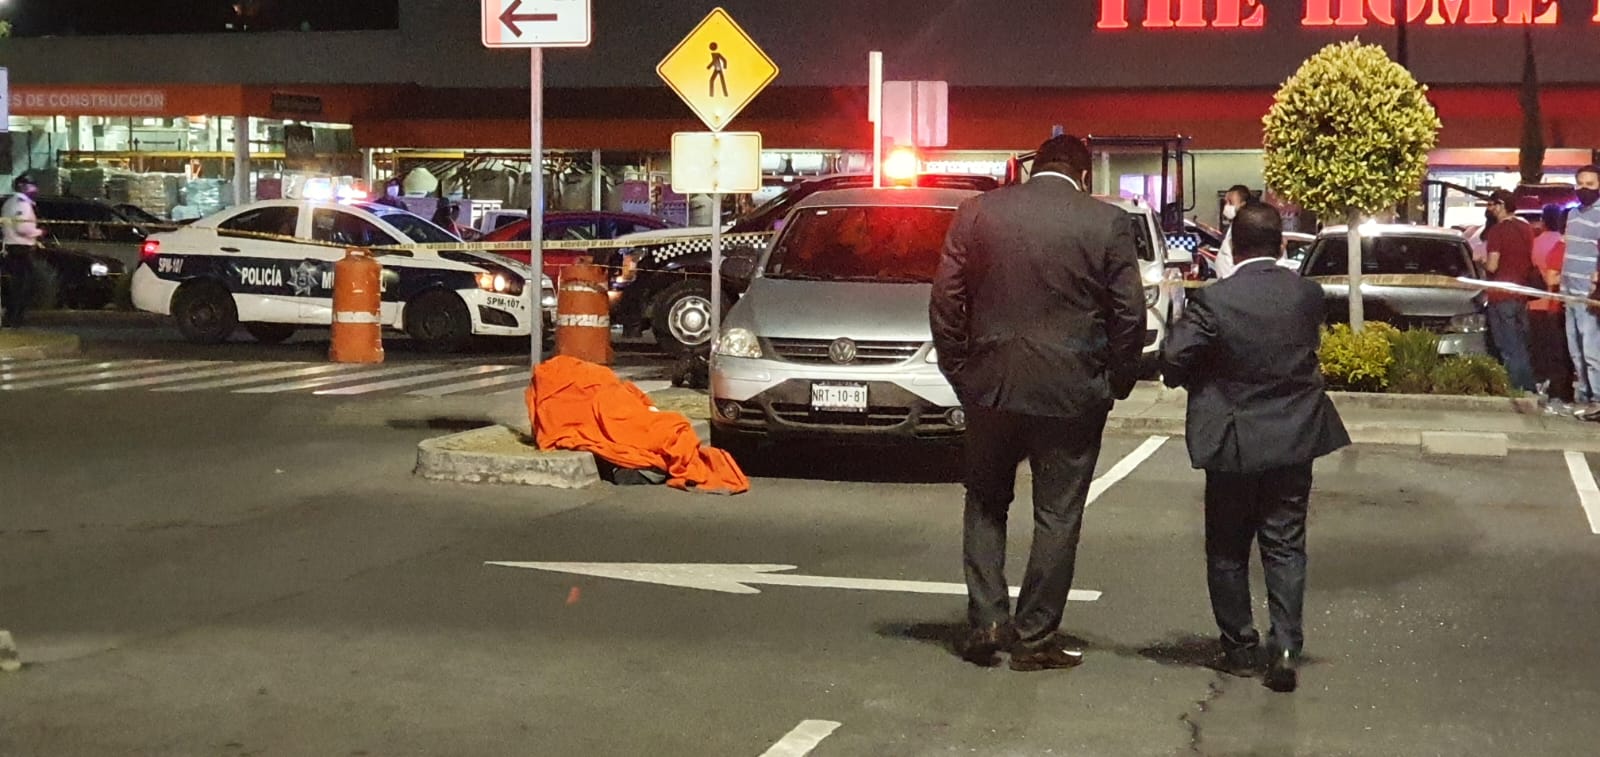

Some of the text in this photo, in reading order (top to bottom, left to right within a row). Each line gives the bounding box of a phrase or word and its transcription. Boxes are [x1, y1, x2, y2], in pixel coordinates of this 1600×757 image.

[26, 94, 45, 107] DE
[241, 265, 282, 287] POLICÍA
[487, 297, 520, 308] SPM-107
[812, 389, 865, 402] NRT-10-81
